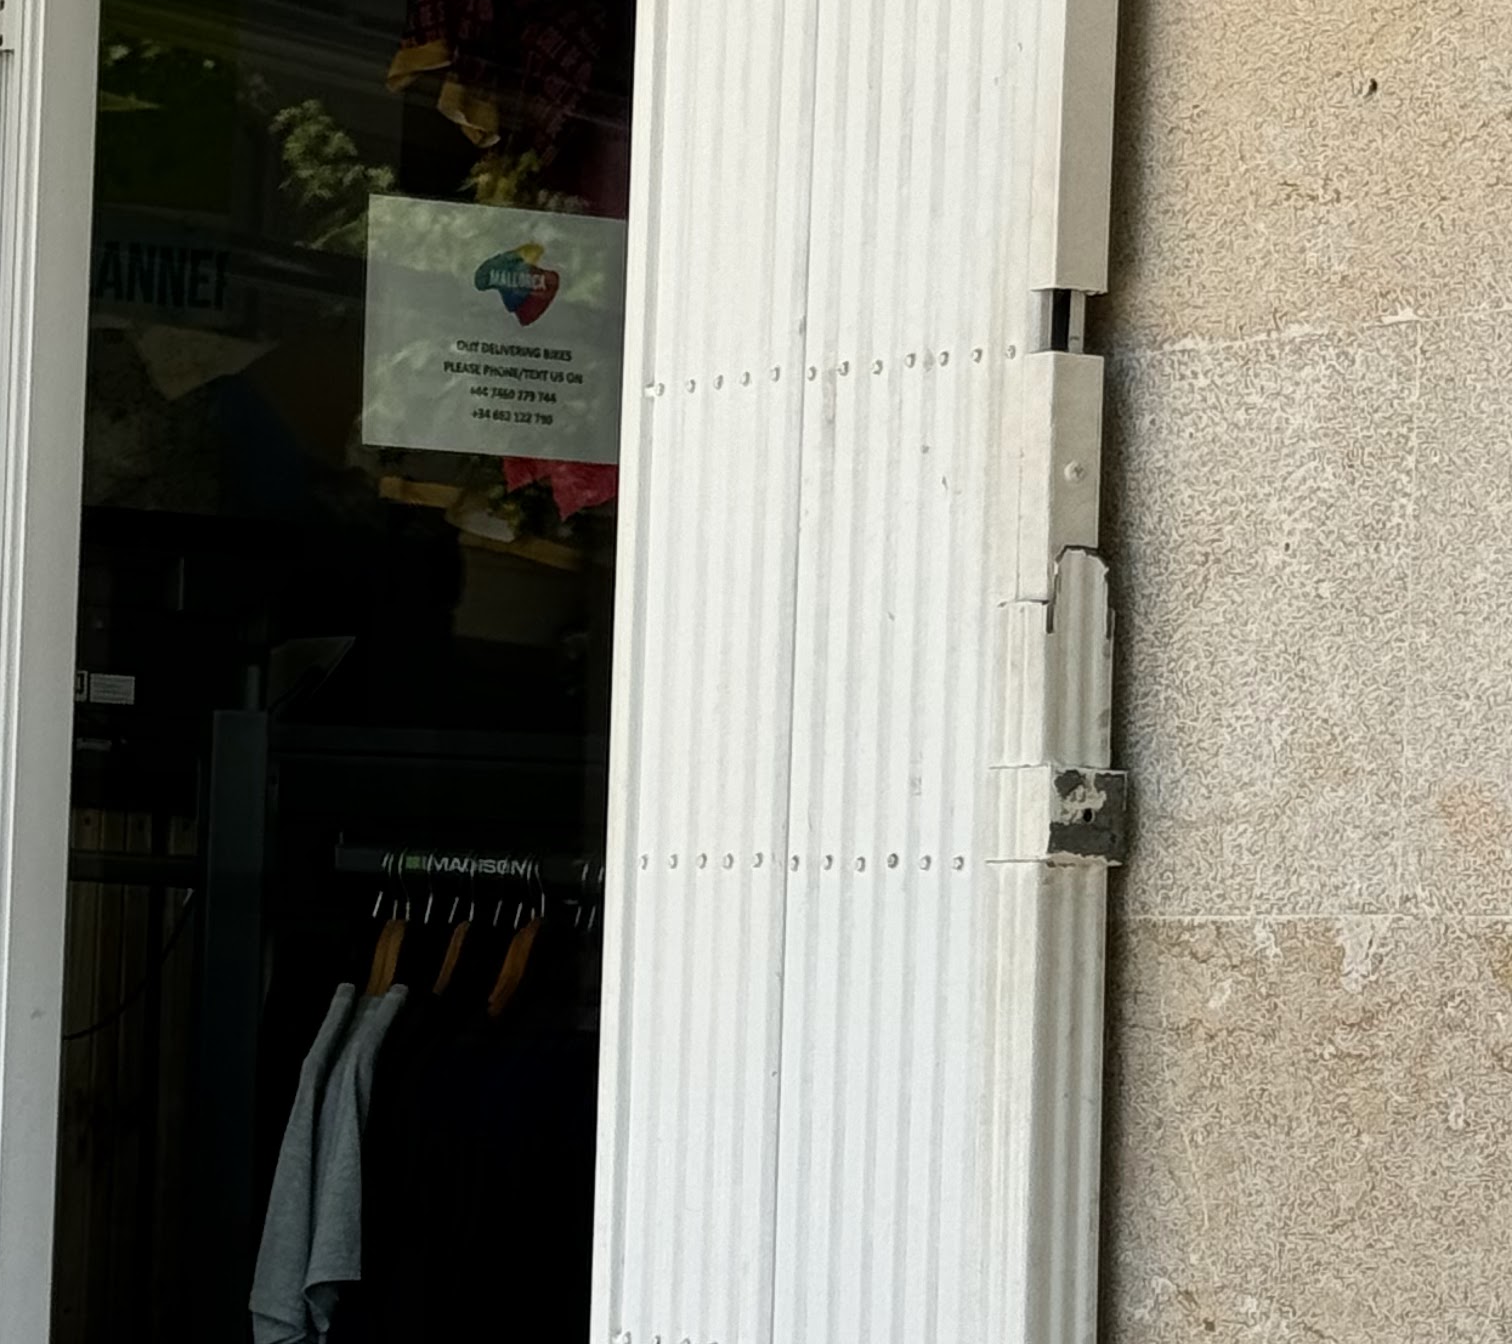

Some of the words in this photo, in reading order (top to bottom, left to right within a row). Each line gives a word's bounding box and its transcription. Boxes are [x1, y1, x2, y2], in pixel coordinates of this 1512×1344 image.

[489, 268, 547, 291] MALLORCA
[456, 340, 479, 353] OUT
[481, 342, 541, 358] DELIVERING
[543, 348, 572, 362] BIKES
[443, 361, 481, 375] PLEASE
[483, 364, 549, 381] PHONE/TEXT
[550, 371, 564, 383] US
[566, 372, 583, 384] ON
